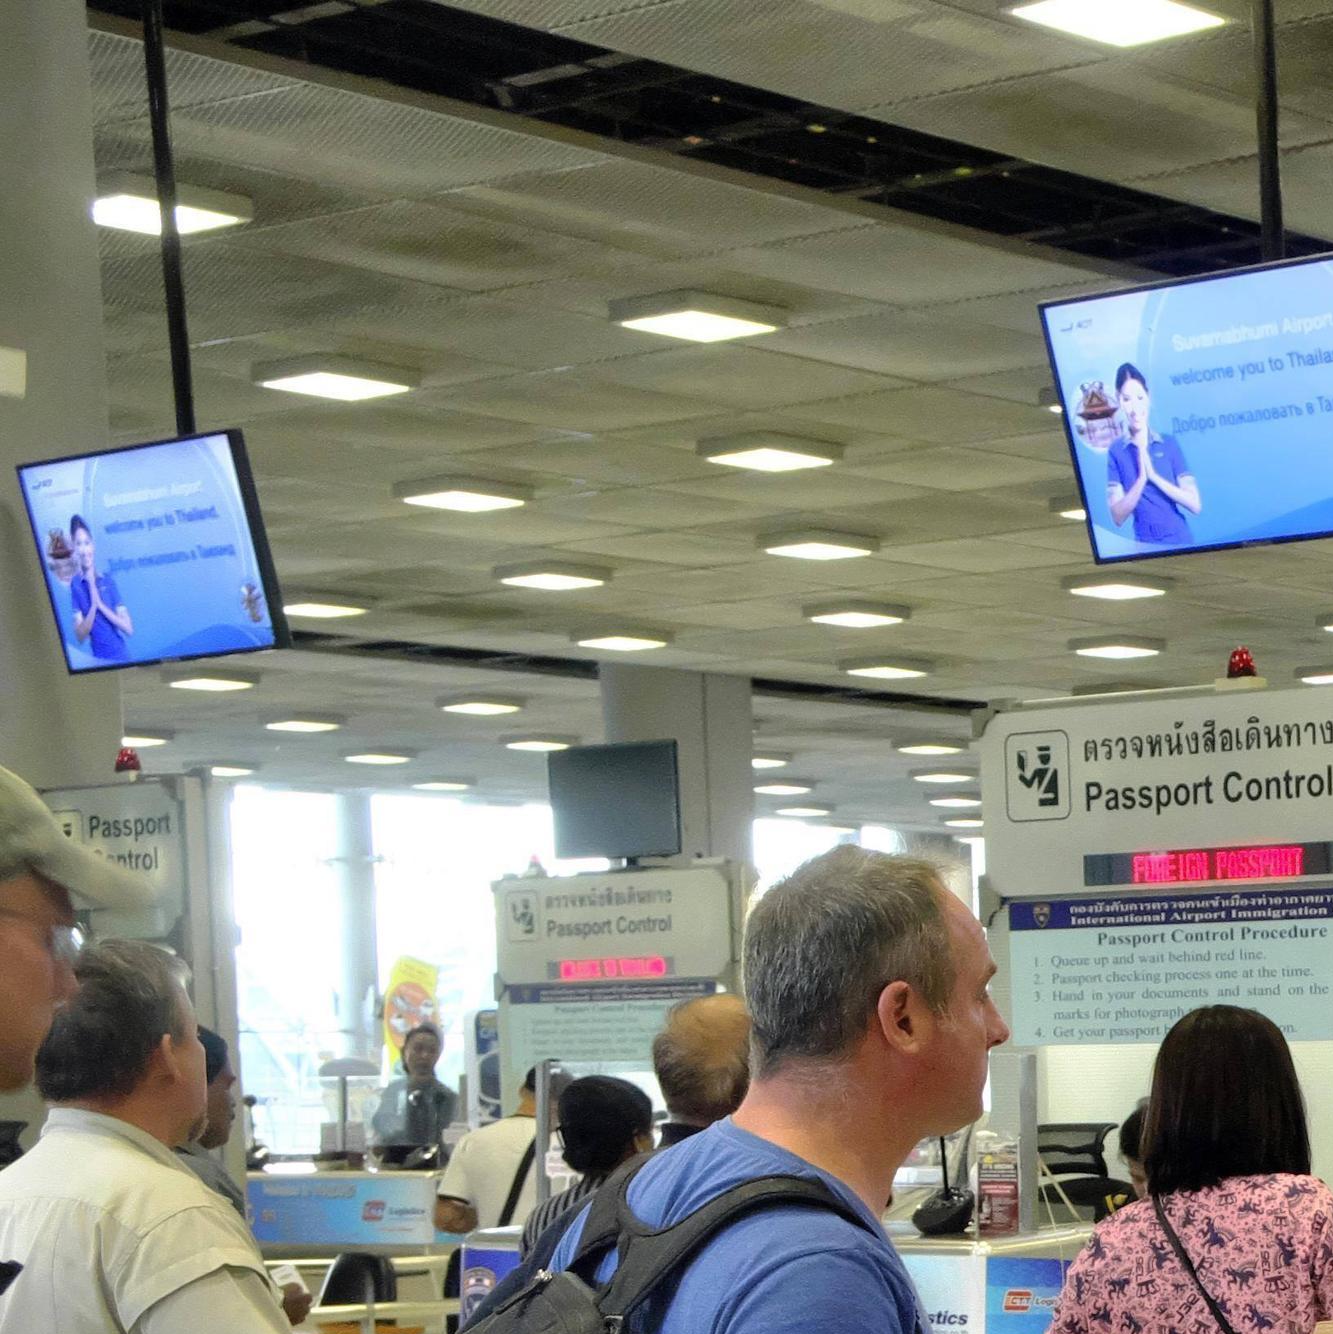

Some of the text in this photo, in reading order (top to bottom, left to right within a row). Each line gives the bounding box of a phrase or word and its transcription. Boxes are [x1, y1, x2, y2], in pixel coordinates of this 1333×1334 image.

[1171, 321, 1279, 352] Suvarnabhumi
[1168, 364, 1235, 386] welcome
[1238, 361, 1265, 381] you
[1268, 357, 1285, 371] to
[1171, 415, 1216, 435] Добро
[1218, 404, 1303, 427] пожаловать
[1306, 401, 1315, 415] в
[1084, 765, 1333, 815] Passport Control
[88, 814, 171, 841] Passport
[1071, 913, 1166, 925] International
[1170, 910, 1226, 922] Airport
[1231, 905, 1328, 919] Immigration
[547, 915, 673, 940] Passport Control
[1097, 925, 1328, 948] Passport Control Procedure
[1051, 949, 1235, 968] Queue up and wait behind red
[1052, 966, 1277, 986] Passport checking process one at the
[1052, 989, 1084, 1001] Hand
[1092, 990, 1103, 1000] in
[1107, 991, 1135, 1004] your
[1141, 987, 1209, 1000] documents
[1217, 985, 1240, 997] and
[1247, 984, 1280, 996] stand
[1288, 986, 1304, 996] on
[1309, 982, 1329, 995] the
[1053, 1008, 1090, 1020] marks
[1094, 1007, 1111, 1019] for
[1115, 1006, 1184, 1021] photograph
[1053, 1026, 1074, 1038] Get
[1078, 1027, 1105, 1040] your
[1109, 1025, 1160, 1039] passport
